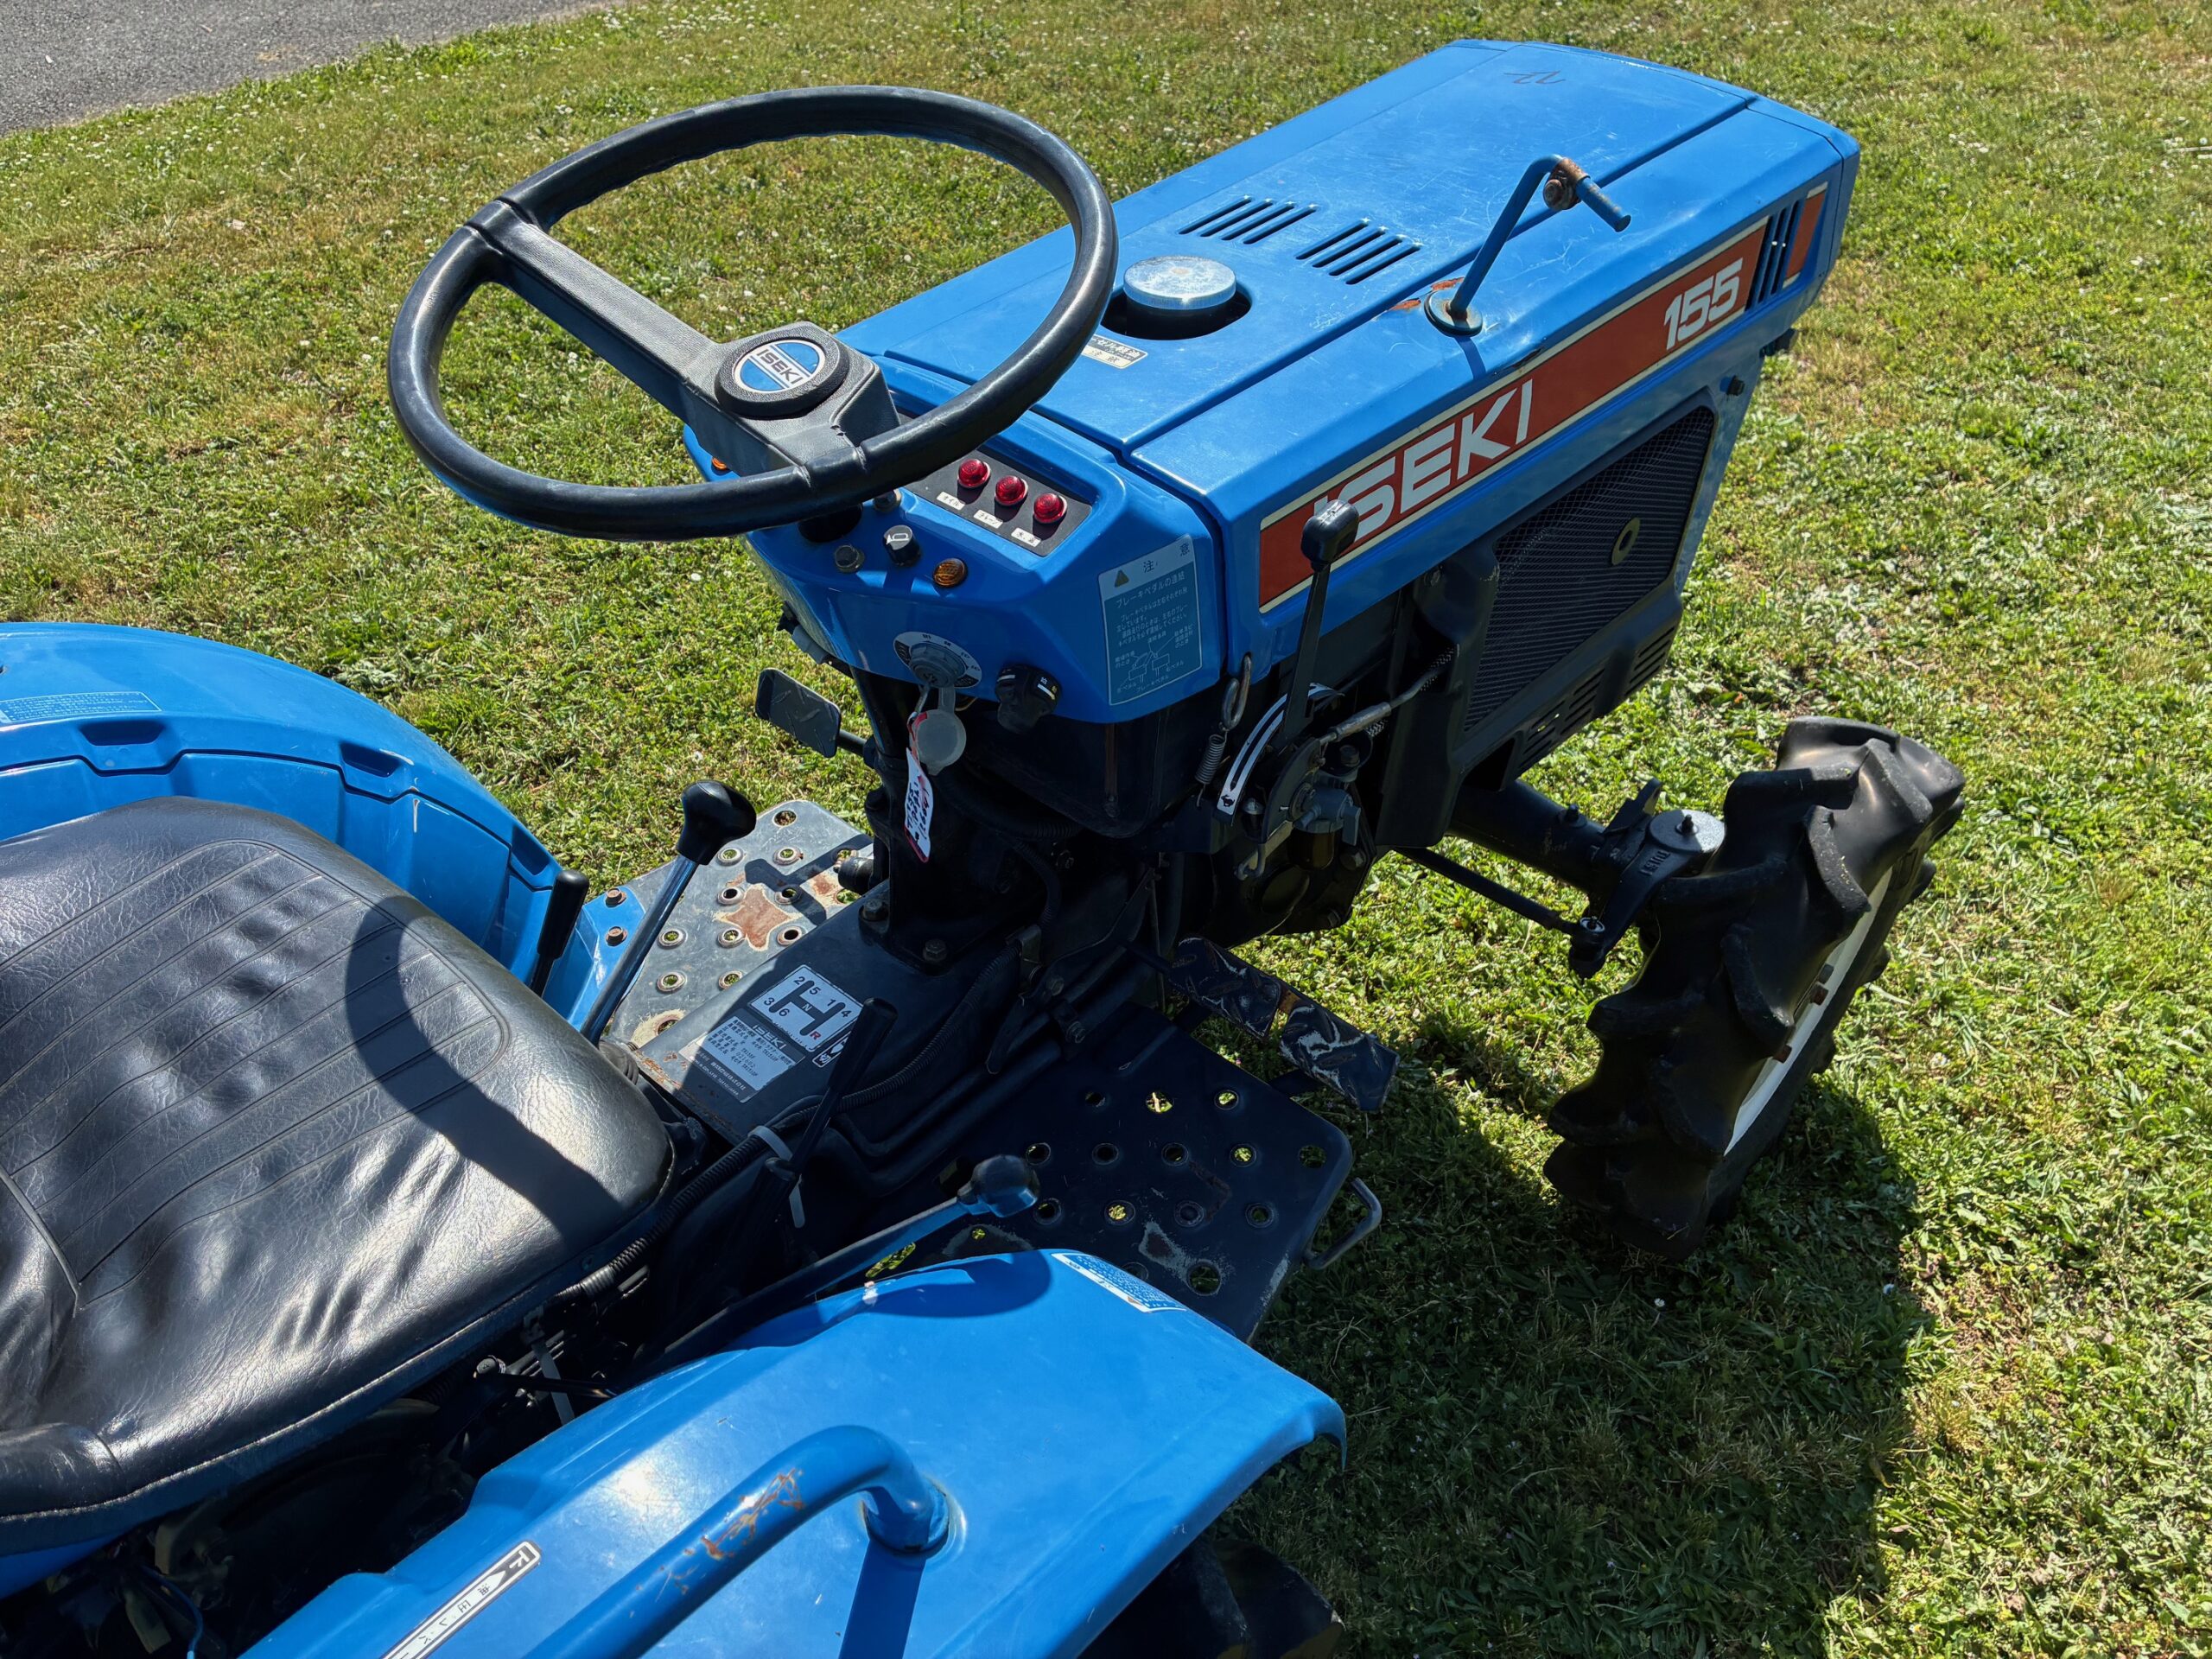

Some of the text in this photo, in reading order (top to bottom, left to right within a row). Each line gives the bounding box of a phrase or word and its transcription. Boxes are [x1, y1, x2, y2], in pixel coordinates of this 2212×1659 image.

[1662, 257, 1744, 351] 155
[756, 348, 804, 385] ISEKI
[793, 976, 853, 1018] 2 5 1 4
[752, 1025, 787, 1050] ISEKI
[764, 997, 774, 1006] 3
[810, 1031, 822, 1040] R
[510, 1550, 530, 1569] 下
